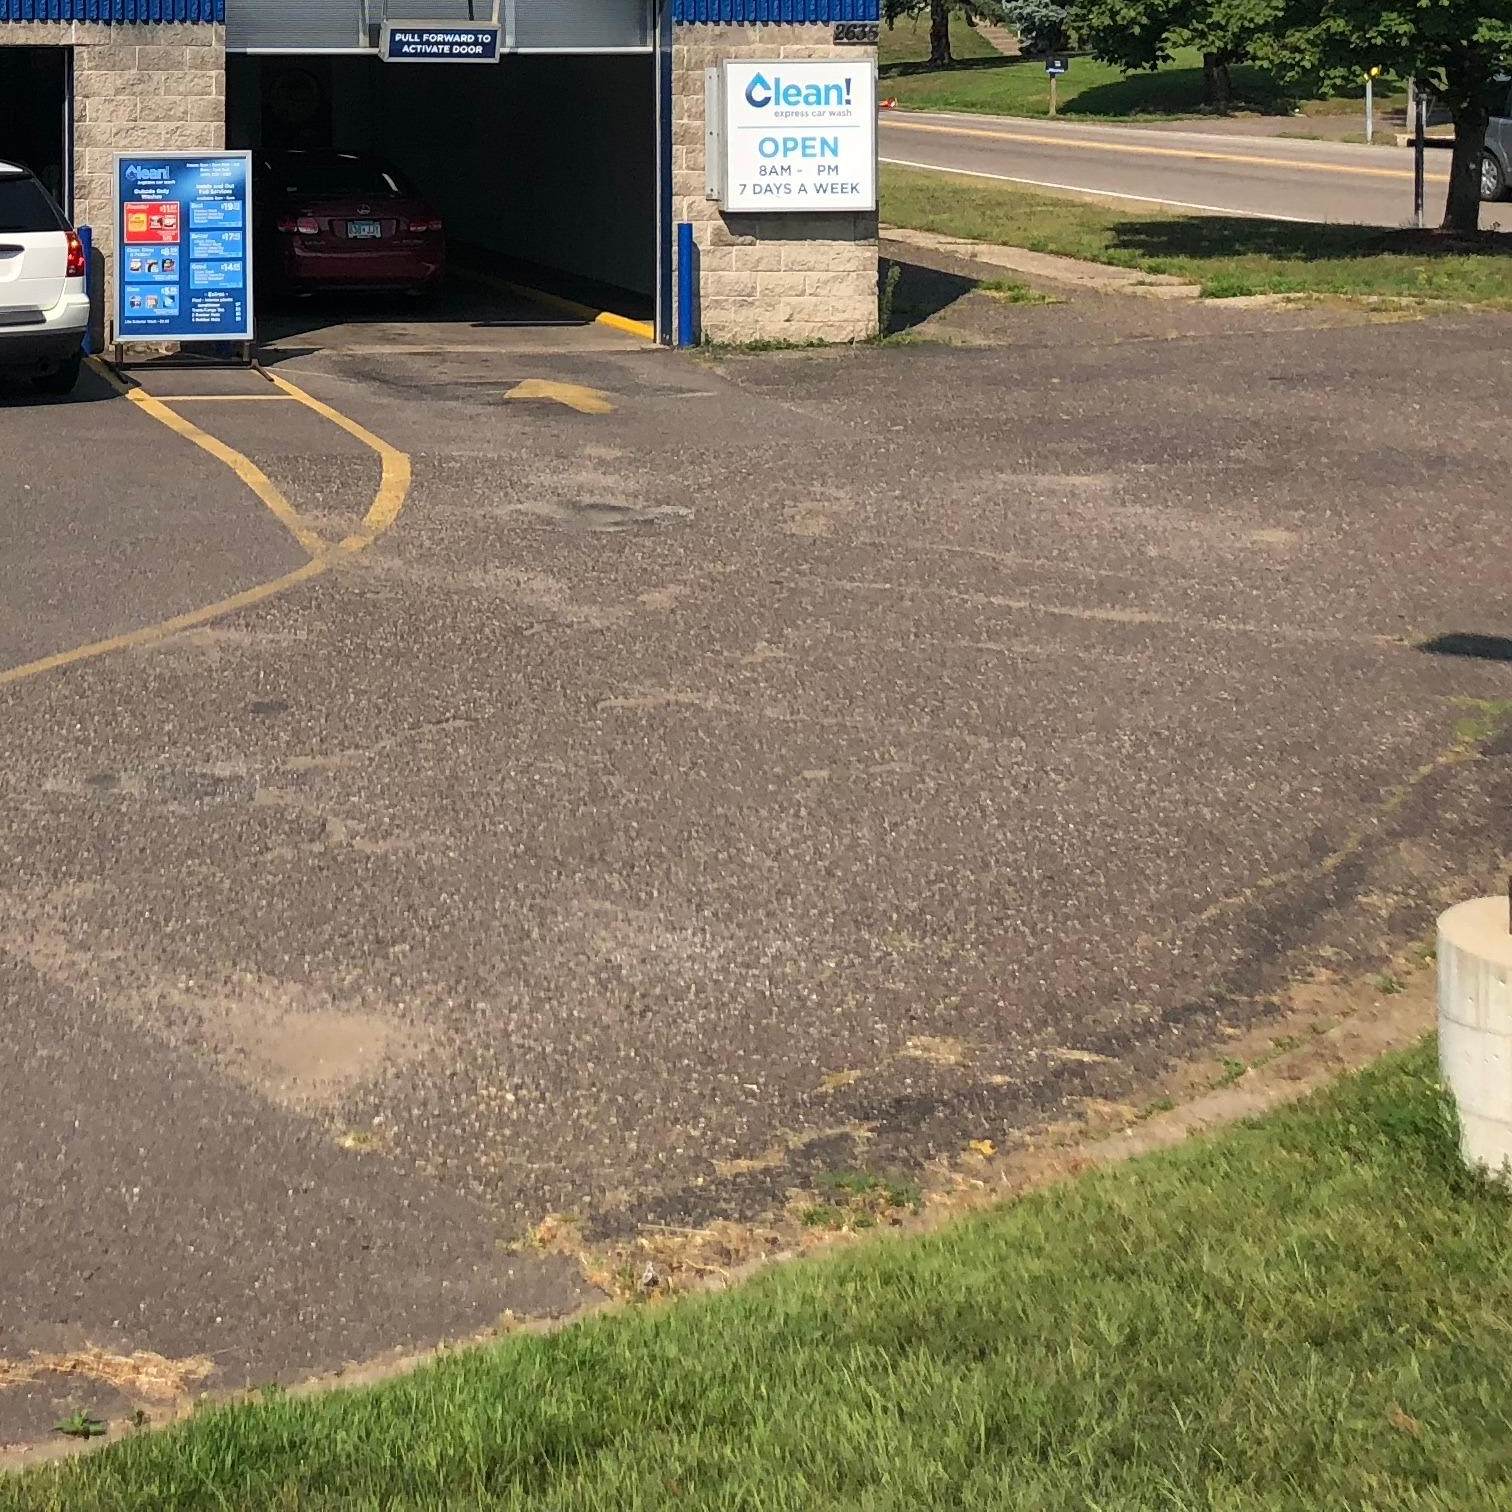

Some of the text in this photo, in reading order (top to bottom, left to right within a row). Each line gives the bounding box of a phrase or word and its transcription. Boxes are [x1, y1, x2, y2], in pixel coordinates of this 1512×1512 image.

[395, 33, 491, 43] PULL FORWARD TO
[402, 44, 483, 54] ACTIVATE DOOR
[745, 71, 852, 108] Clean!
[774, 110, 809, 119] express
[828, 108, 852, 117] wash
[758, 136, 838, 158] OPEN
[759, 164, 792, 176] 8AM
[817, 164, 839, 176] PM
[739, 182, 860, 195] 7 DAYS A WEEK
